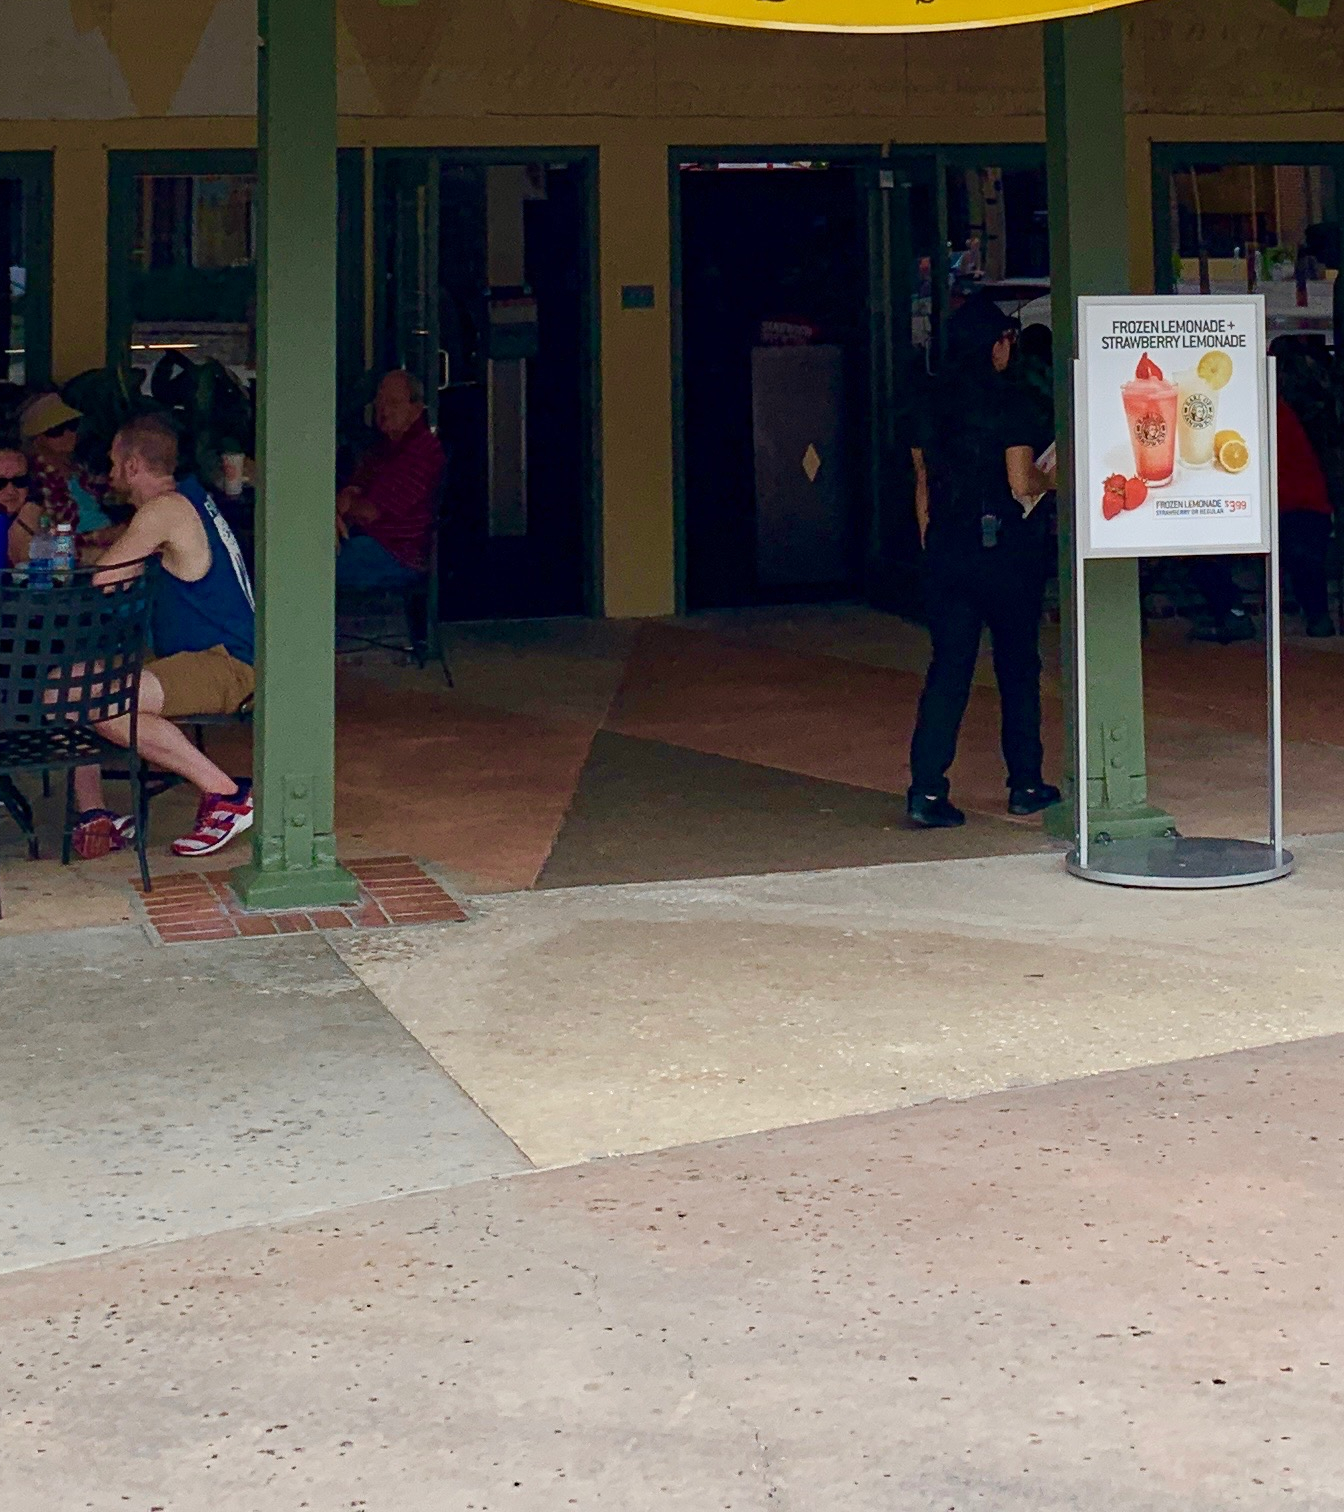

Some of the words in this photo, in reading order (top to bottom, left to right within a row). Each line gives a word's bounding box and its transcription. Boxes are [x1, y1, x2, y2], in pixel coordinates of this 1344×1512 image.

[1112, 320, 1159, 334] FROZEN
[1161, 319, 1226, 334] LEMONADE
[1101, 335, 1181, 350] STRAWBERRY
[1182, 334, 1247, 348] LEMONADE
[1156, 500, 1184, 509] FROZEN
[1184, 499, 1222, 508] LEMONADE
